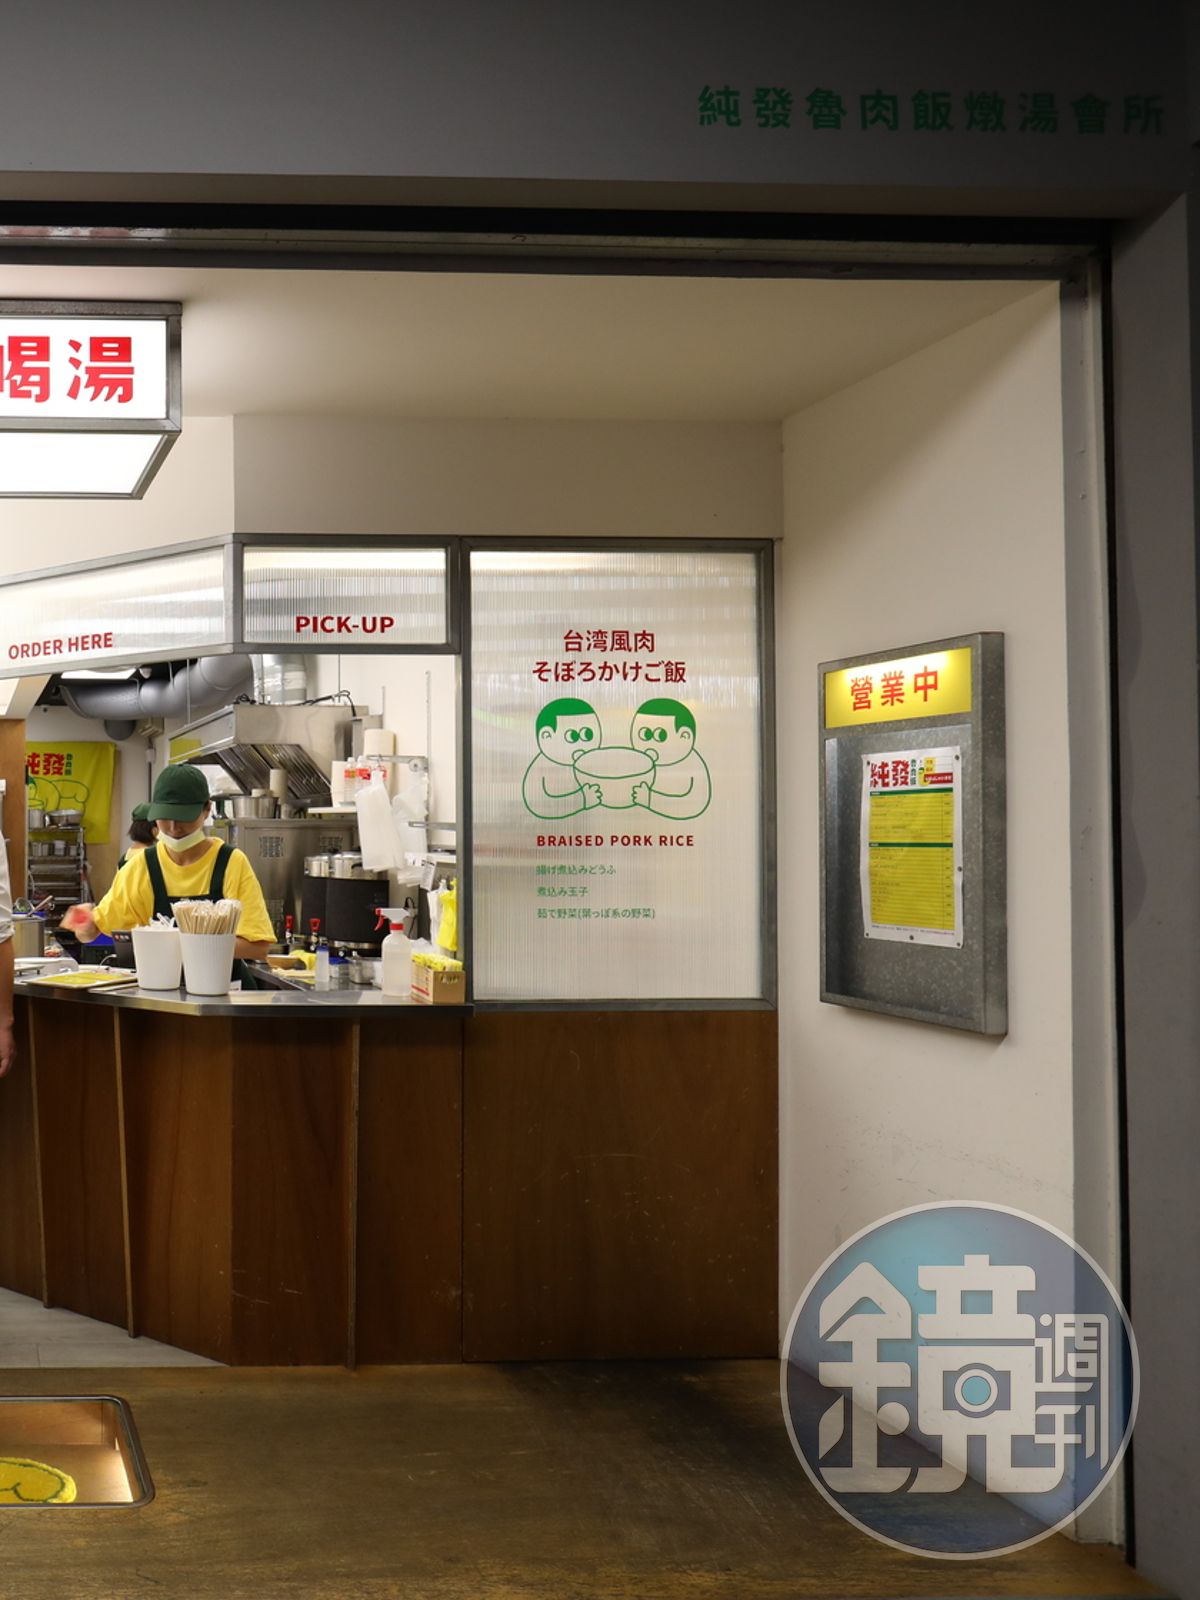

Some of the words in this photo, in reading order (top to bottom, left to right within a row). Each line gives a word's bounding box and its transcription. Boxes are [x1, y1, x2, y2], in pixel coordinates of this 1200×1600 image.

[698, 84, 1165, 136] 純發魯肉飯燉湯會所
[295, 615, 394, 634] PICK-UP
[8, 638, 64, 660] ORDER
[67, 631, 114, 652] HERE
[563, 629, 655, 653] 台湾風肉
[532, 659, 687, 683] そぼろかけご飯
[851, 665, 938, 711] 營業中
[536, 834, 604, 847] BRAISED
[610, 834, 653, 847] PORK
[659, 834, 694, 847] RICE
